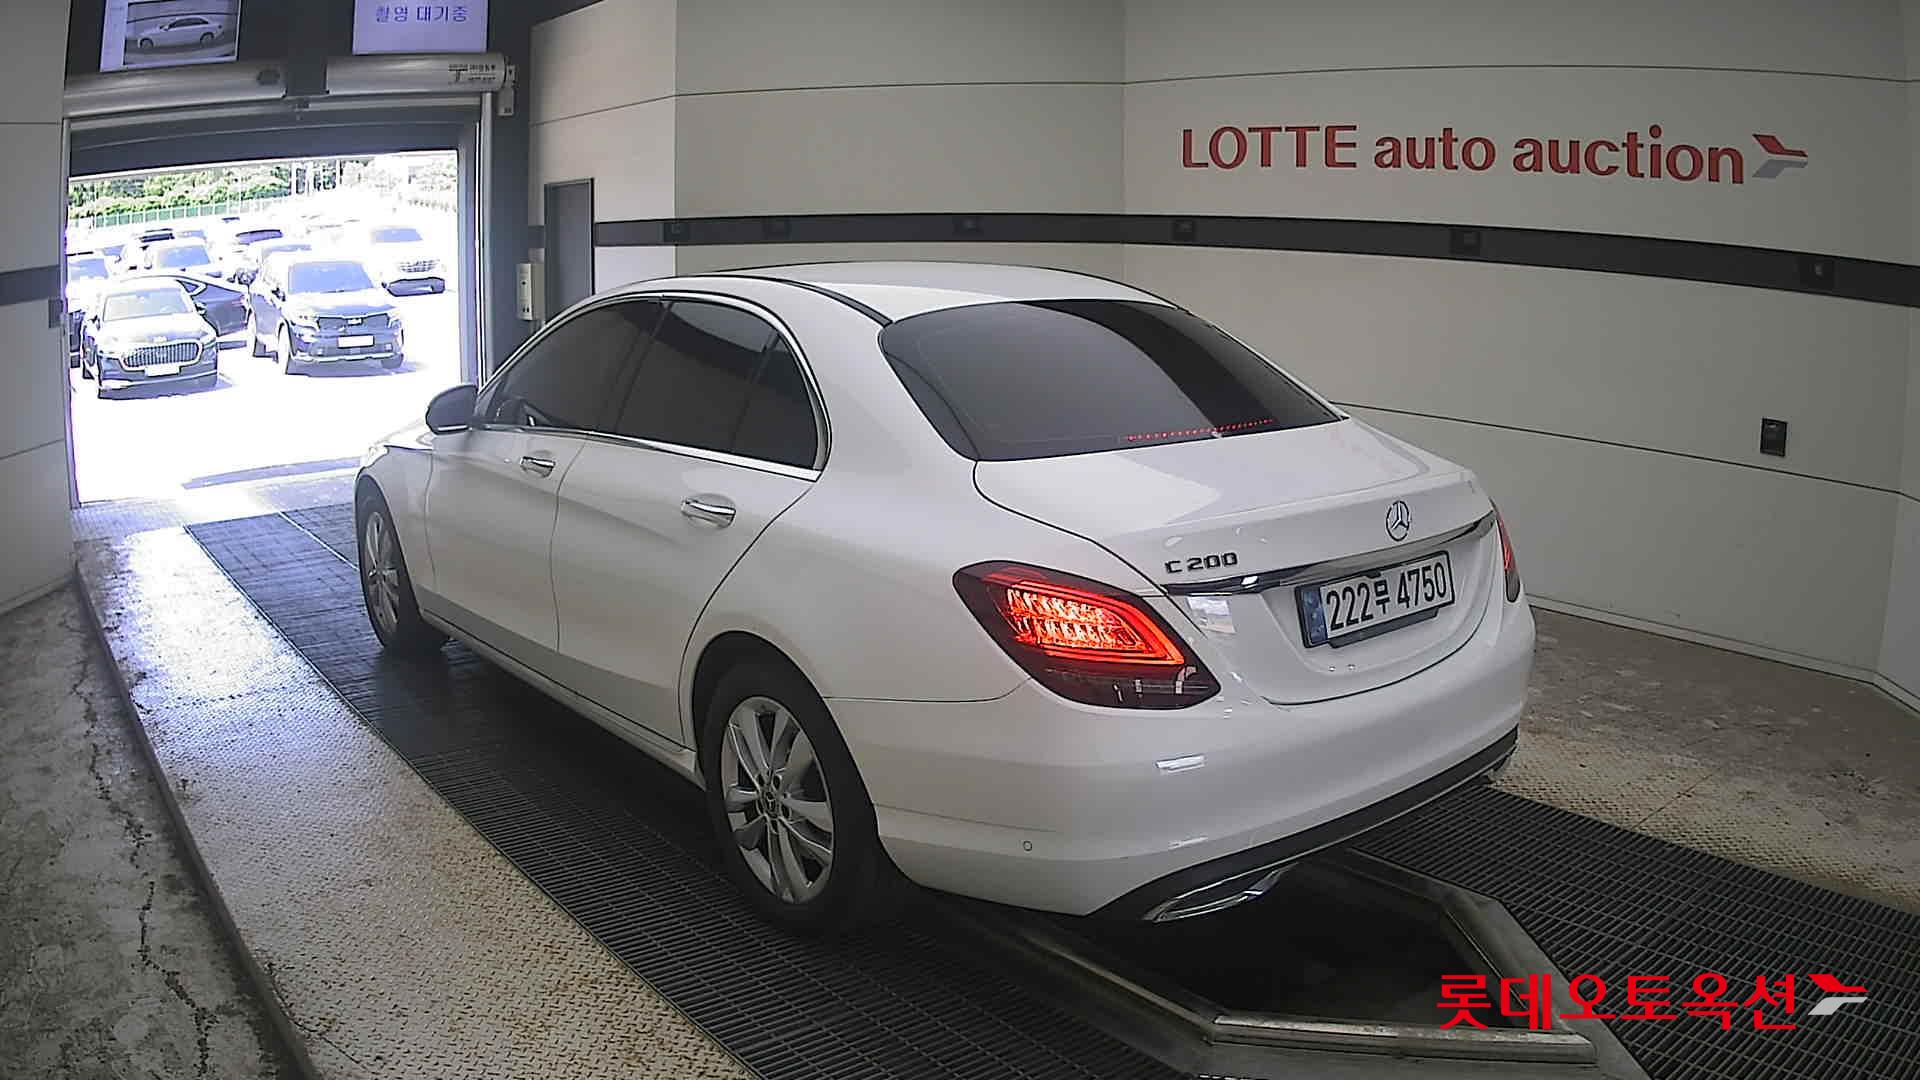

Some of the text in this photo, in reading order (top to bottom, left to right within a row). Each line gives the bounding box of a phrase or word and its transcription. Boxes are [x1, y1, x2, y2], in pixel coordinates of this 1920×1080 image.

[416, 5, 468, 23] 대기중
[1183, 124, 1745, 184] LOTTE auto auction
[1165, 552, 1238, 574] C 200
[1326, 580, 1391, 632] 222무
[1397, 561, 1448, 608] 4750
